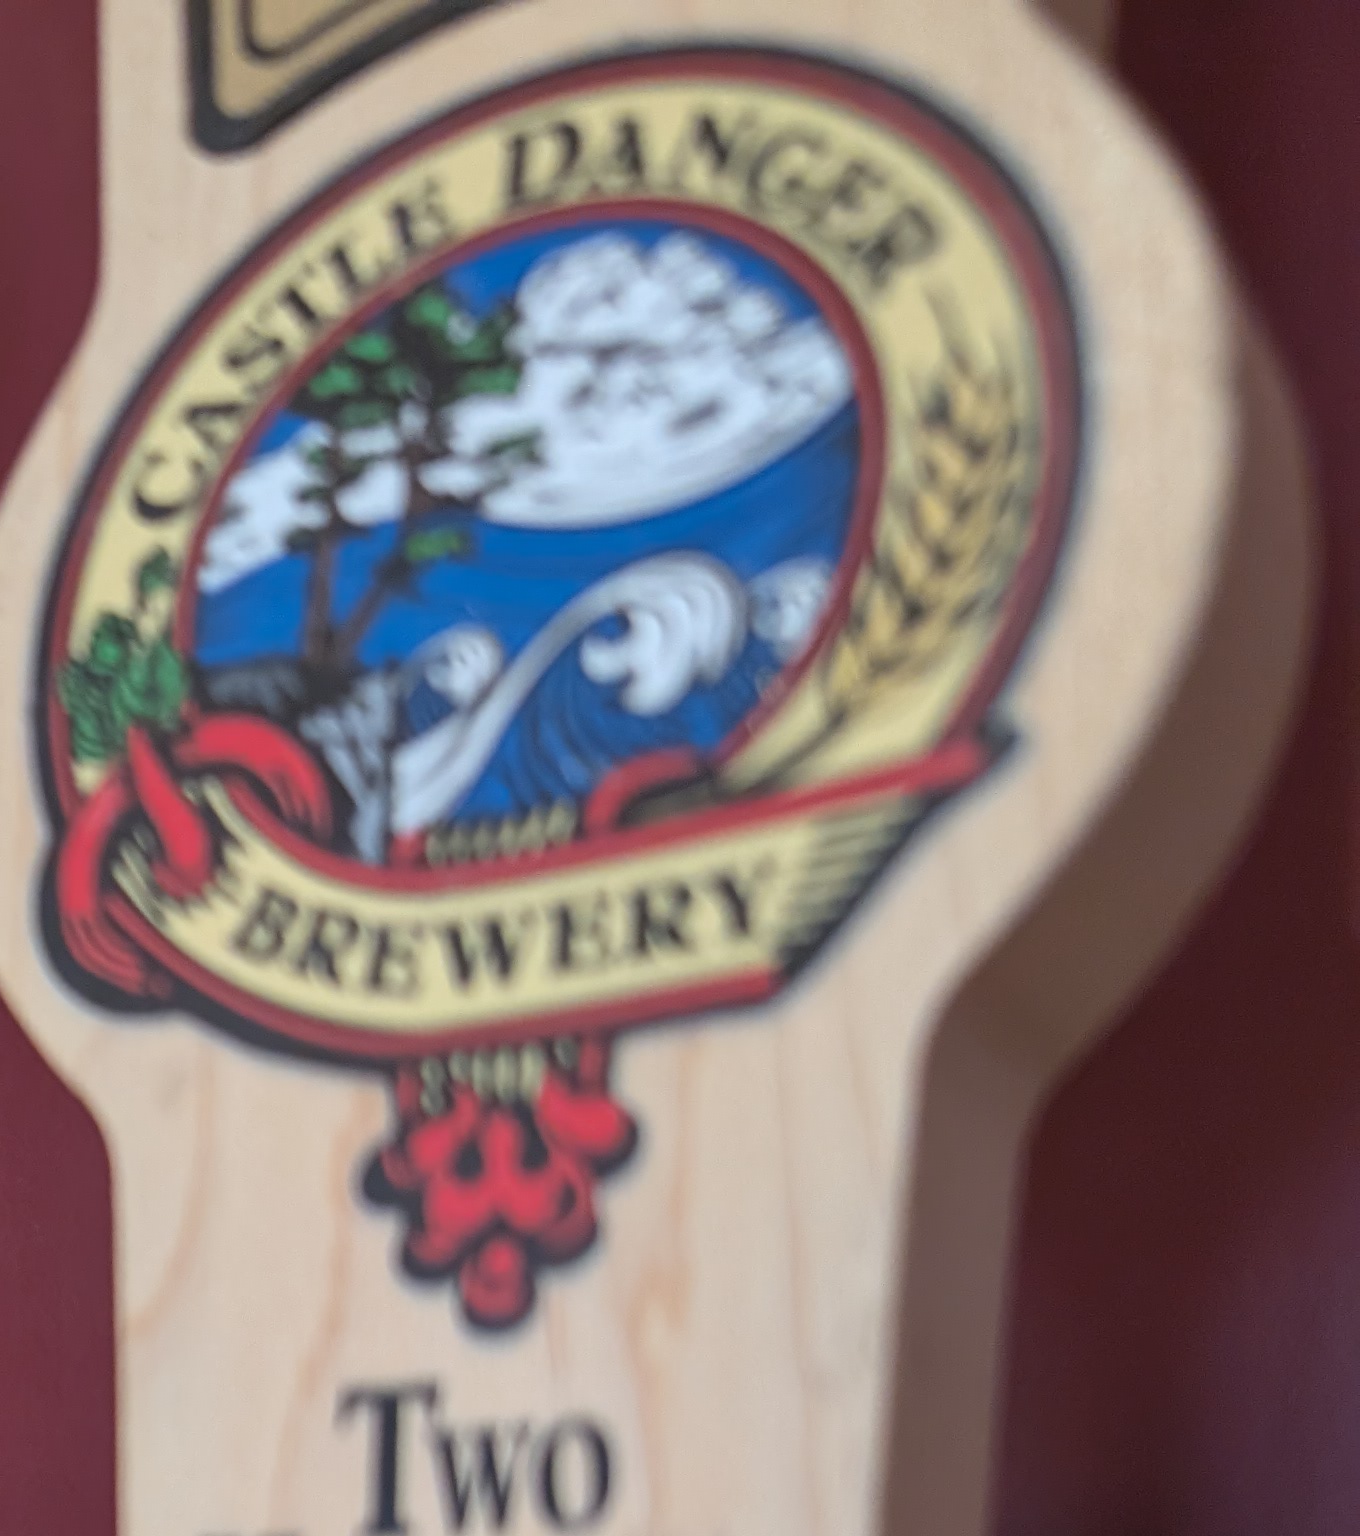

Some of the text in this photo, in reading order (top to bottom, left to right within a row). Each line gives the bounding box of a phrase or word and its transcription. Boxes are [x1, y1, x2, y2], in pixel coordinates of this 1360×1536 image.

[132, 104, 943, 527] CASTLE DANGER
[228, 853, 779, 1004] BREWERY
